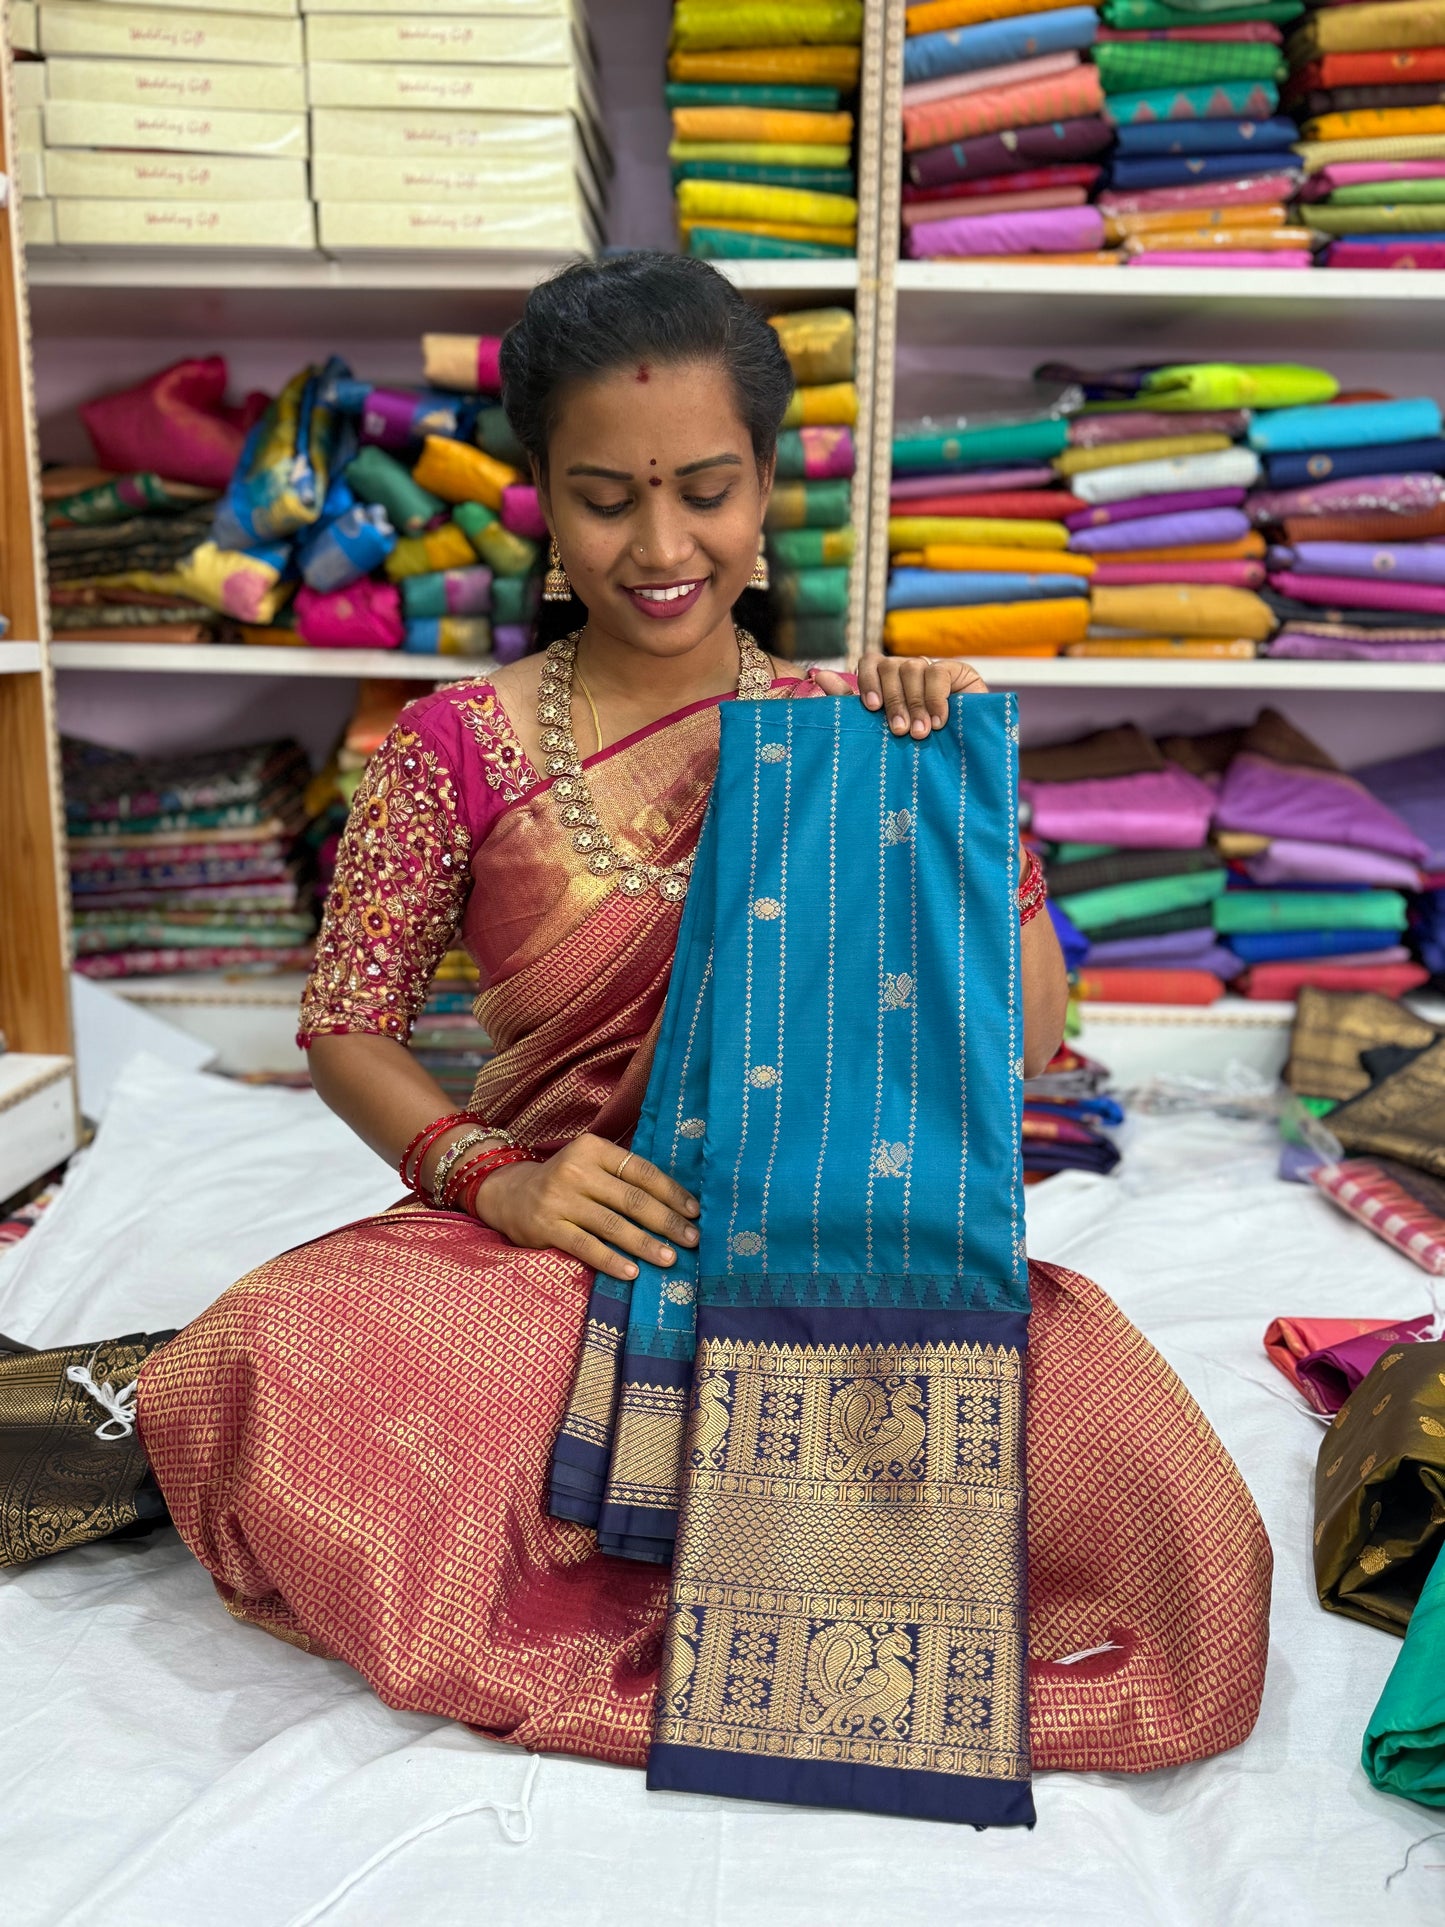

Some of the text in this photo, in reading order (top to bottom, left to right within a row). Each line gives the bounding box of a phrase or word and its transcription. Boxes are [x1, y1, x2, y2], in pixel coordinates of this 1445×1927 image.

[129, 28, 178, 44] Wedding
[136, 77, 184, 93] Wedding
[135, 118, 184, 134] Wedding
[135, 167, 184, 183] Wedding
[145, 213, 193, 229] Wedding
